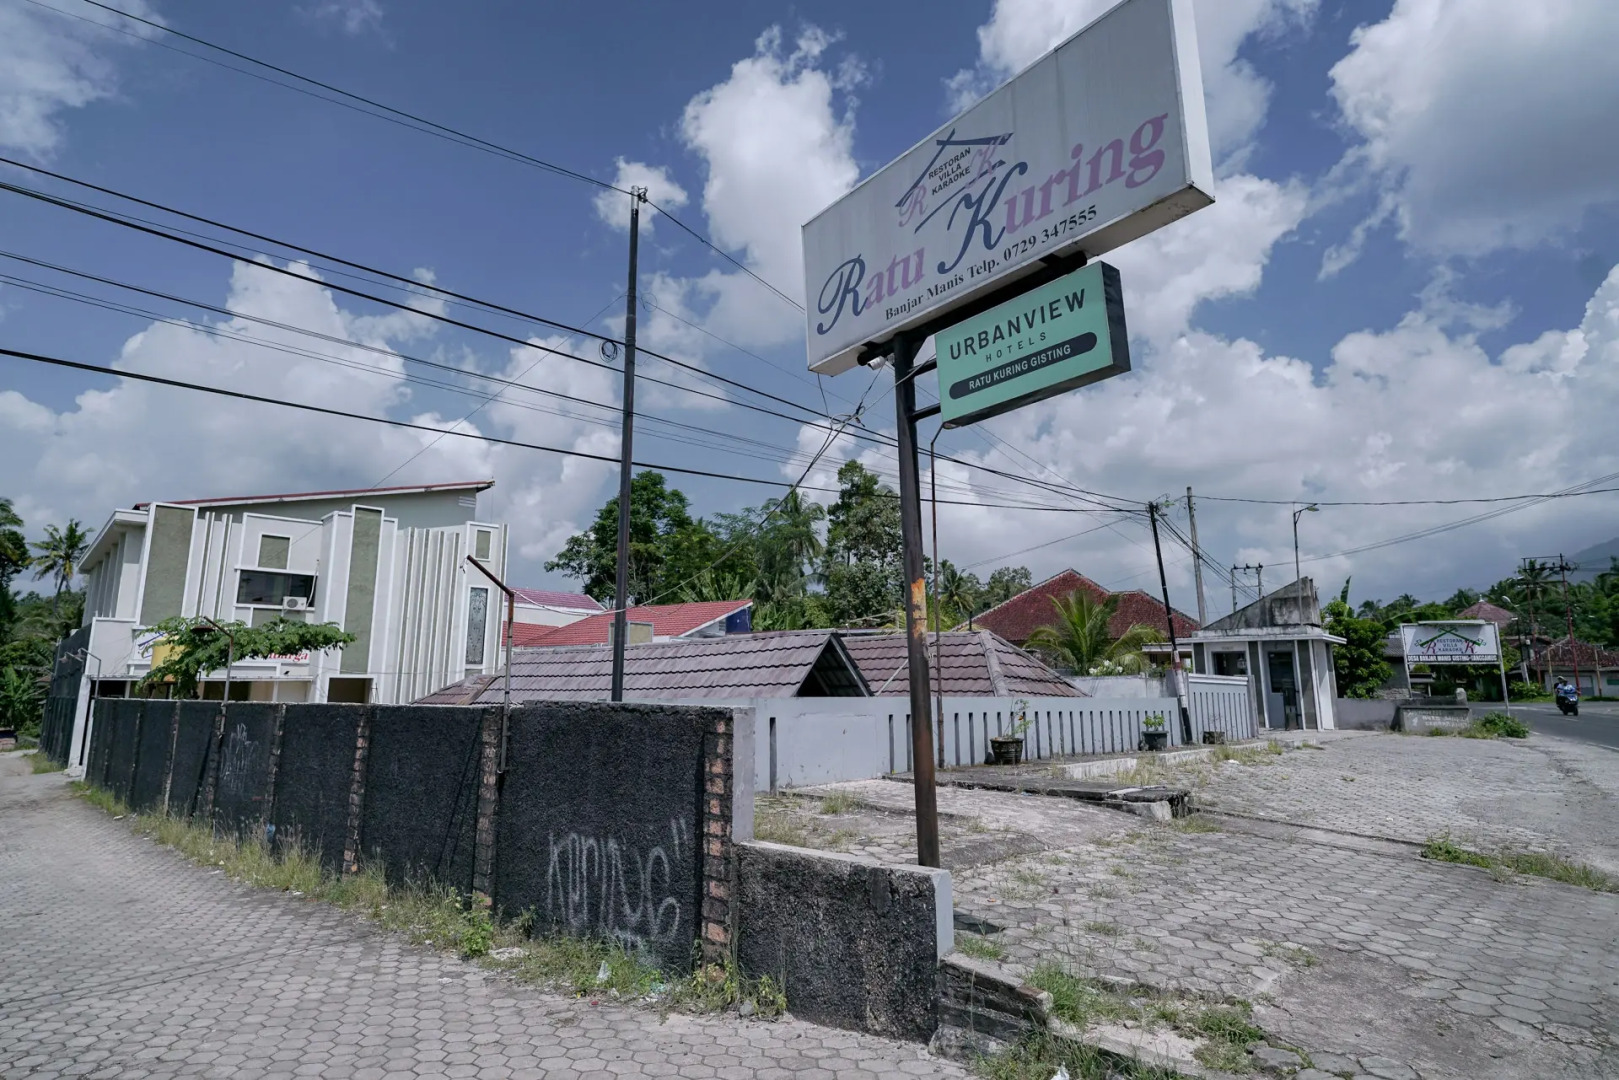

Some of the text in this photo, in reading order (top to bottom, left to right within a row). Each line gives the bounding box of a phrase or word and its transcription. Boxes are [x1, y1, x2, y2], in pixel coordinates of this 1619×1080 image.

[928, 147, 971, 180] RESTORAN
[931, 166, 971, 196] KARAOKE
[938, 163, 962, 182] VILLA
[817, 112, 1169, 335] Ratu Kuring
[885, 204, 1097, 320] Banjar Manis Telp. 0729 347555
[949, 288, 1086, 361] URBANVIEW
[985, 331, 1047, 363] HOTELS
[968, 344, 1071, 390] RATU KURING GISTING
